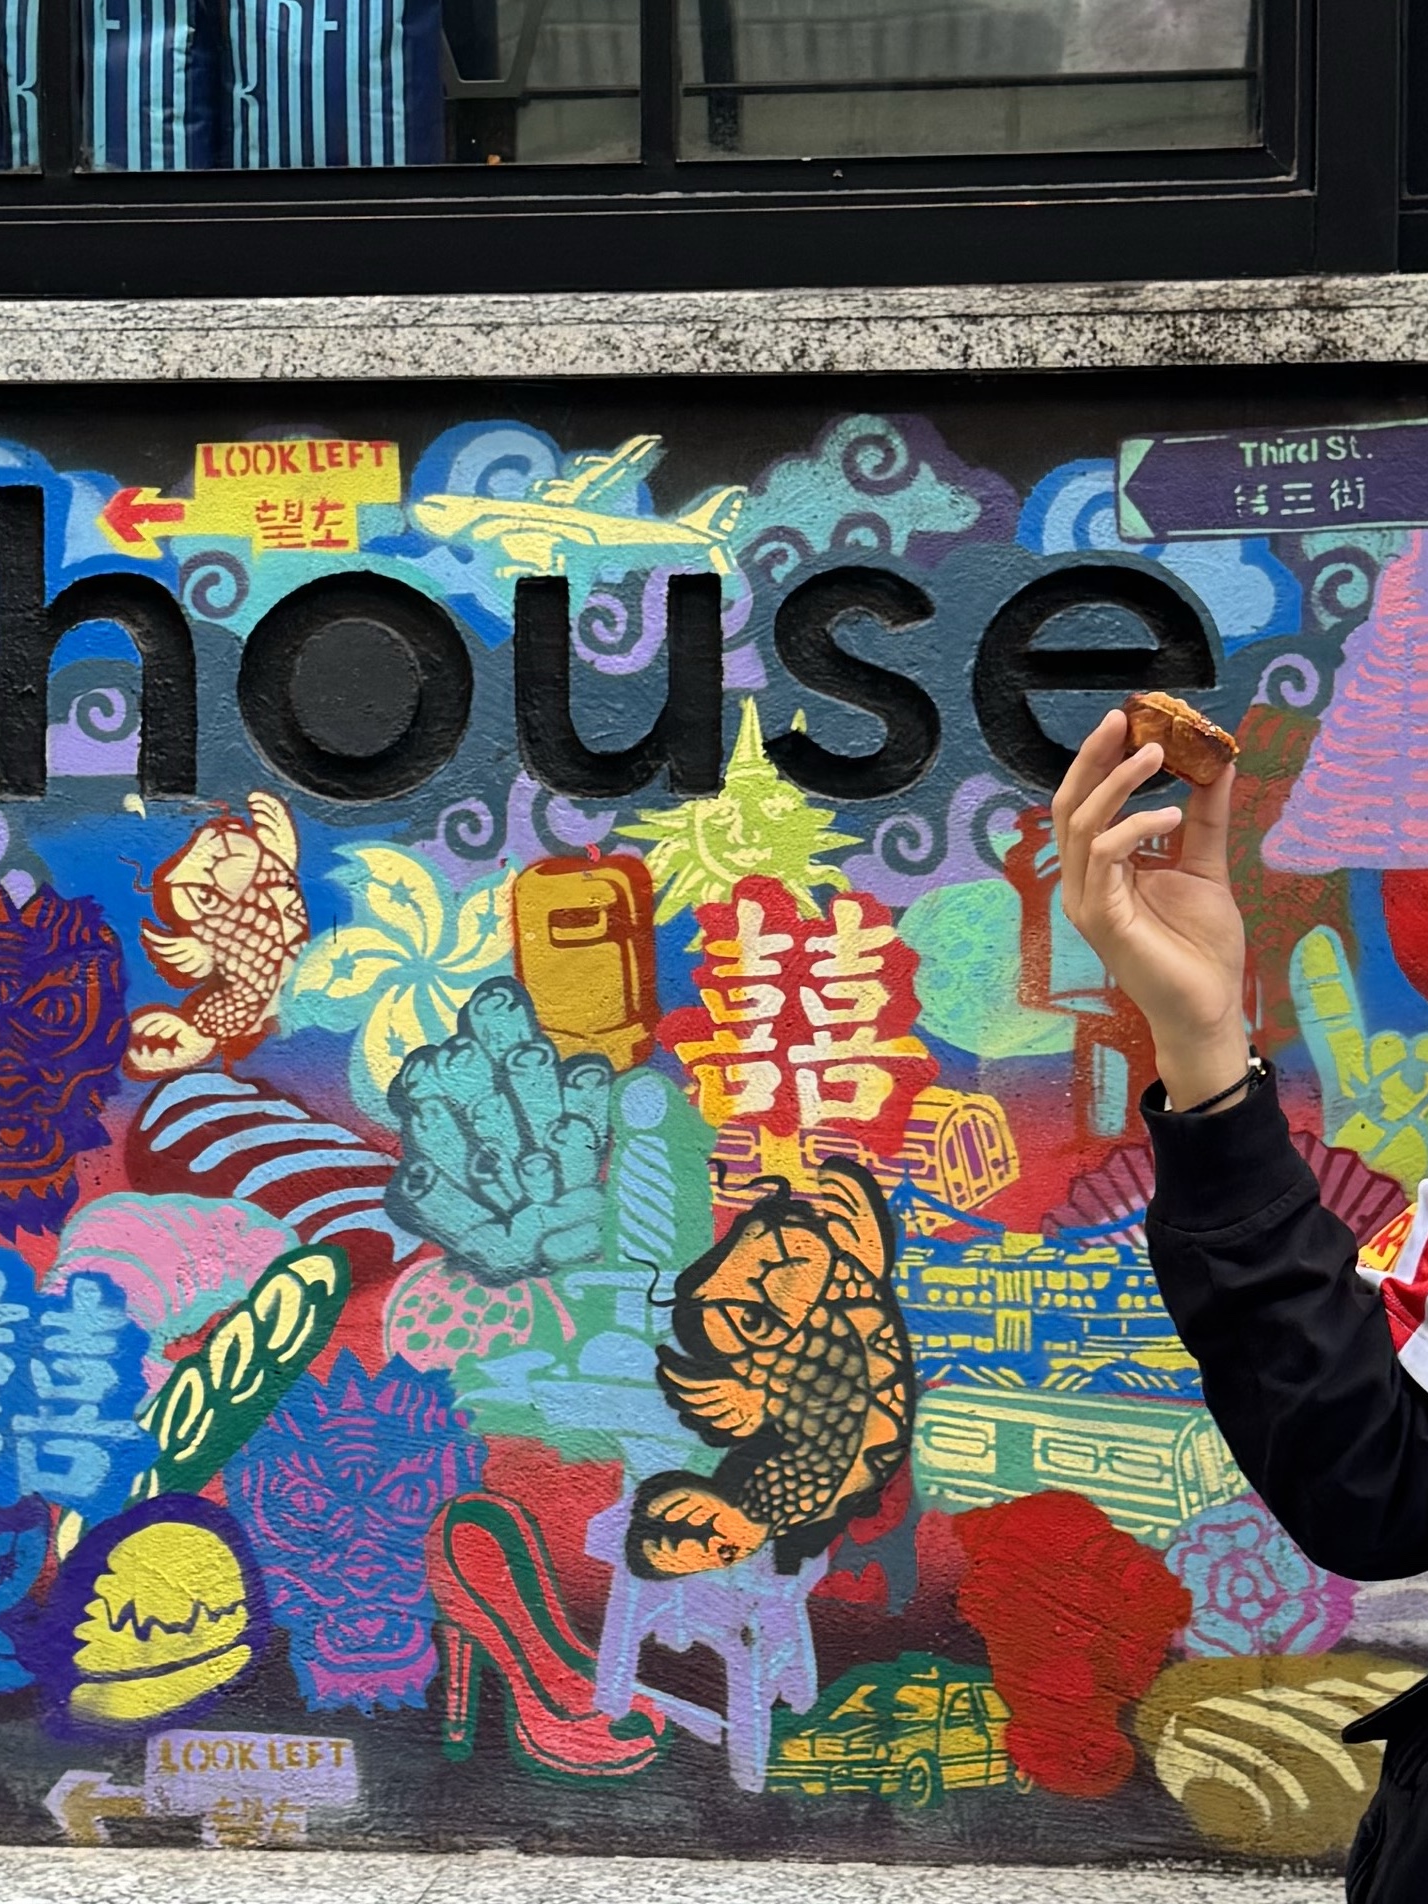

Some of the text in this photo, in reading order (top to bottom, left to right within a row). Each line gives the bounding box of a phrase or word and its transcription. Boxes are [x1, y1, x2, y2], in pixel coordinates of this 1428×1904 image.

[201, 439, 392, 479] LOOK LEFT
[1238, 434, 1374, 468] Third St.
[157, 1738, 349, 1776] LOOK LEFT
